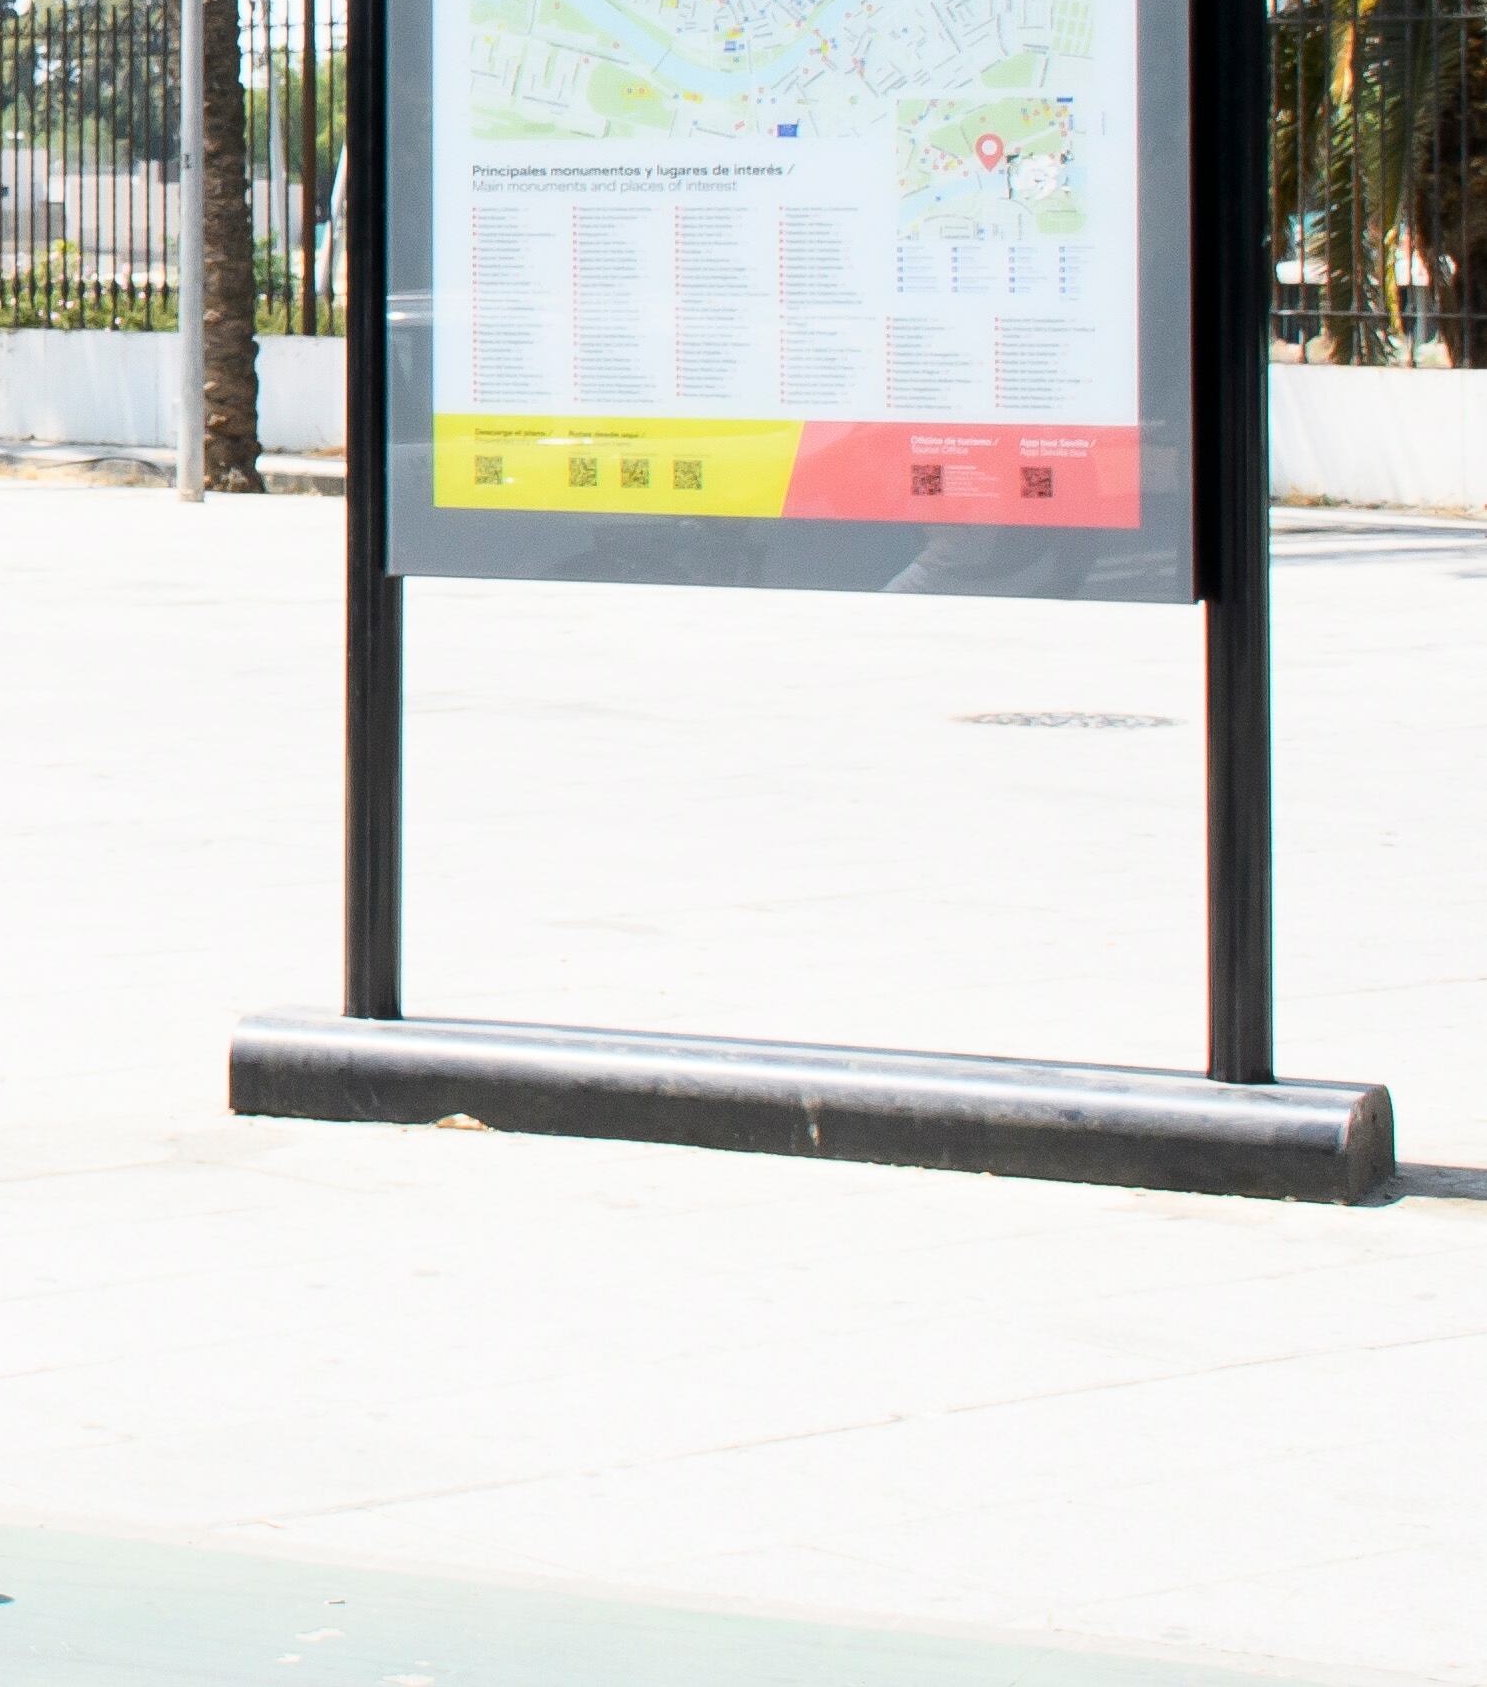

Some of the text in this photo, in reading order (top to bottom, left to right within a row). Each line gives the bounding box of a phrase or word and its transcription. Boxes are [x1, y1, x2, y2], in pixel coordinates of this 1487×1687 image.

[472, 164, 547, 180] Principales
[550, 165, 641, 177] monumentos
[644, 166, 653, 179] y
[657, 164, 708, 180] lugares
[712, 164, 730, 176] de
[733, 163, 783, 176] interés
[472, 179, 738, 194] Main monuments and places of interest
